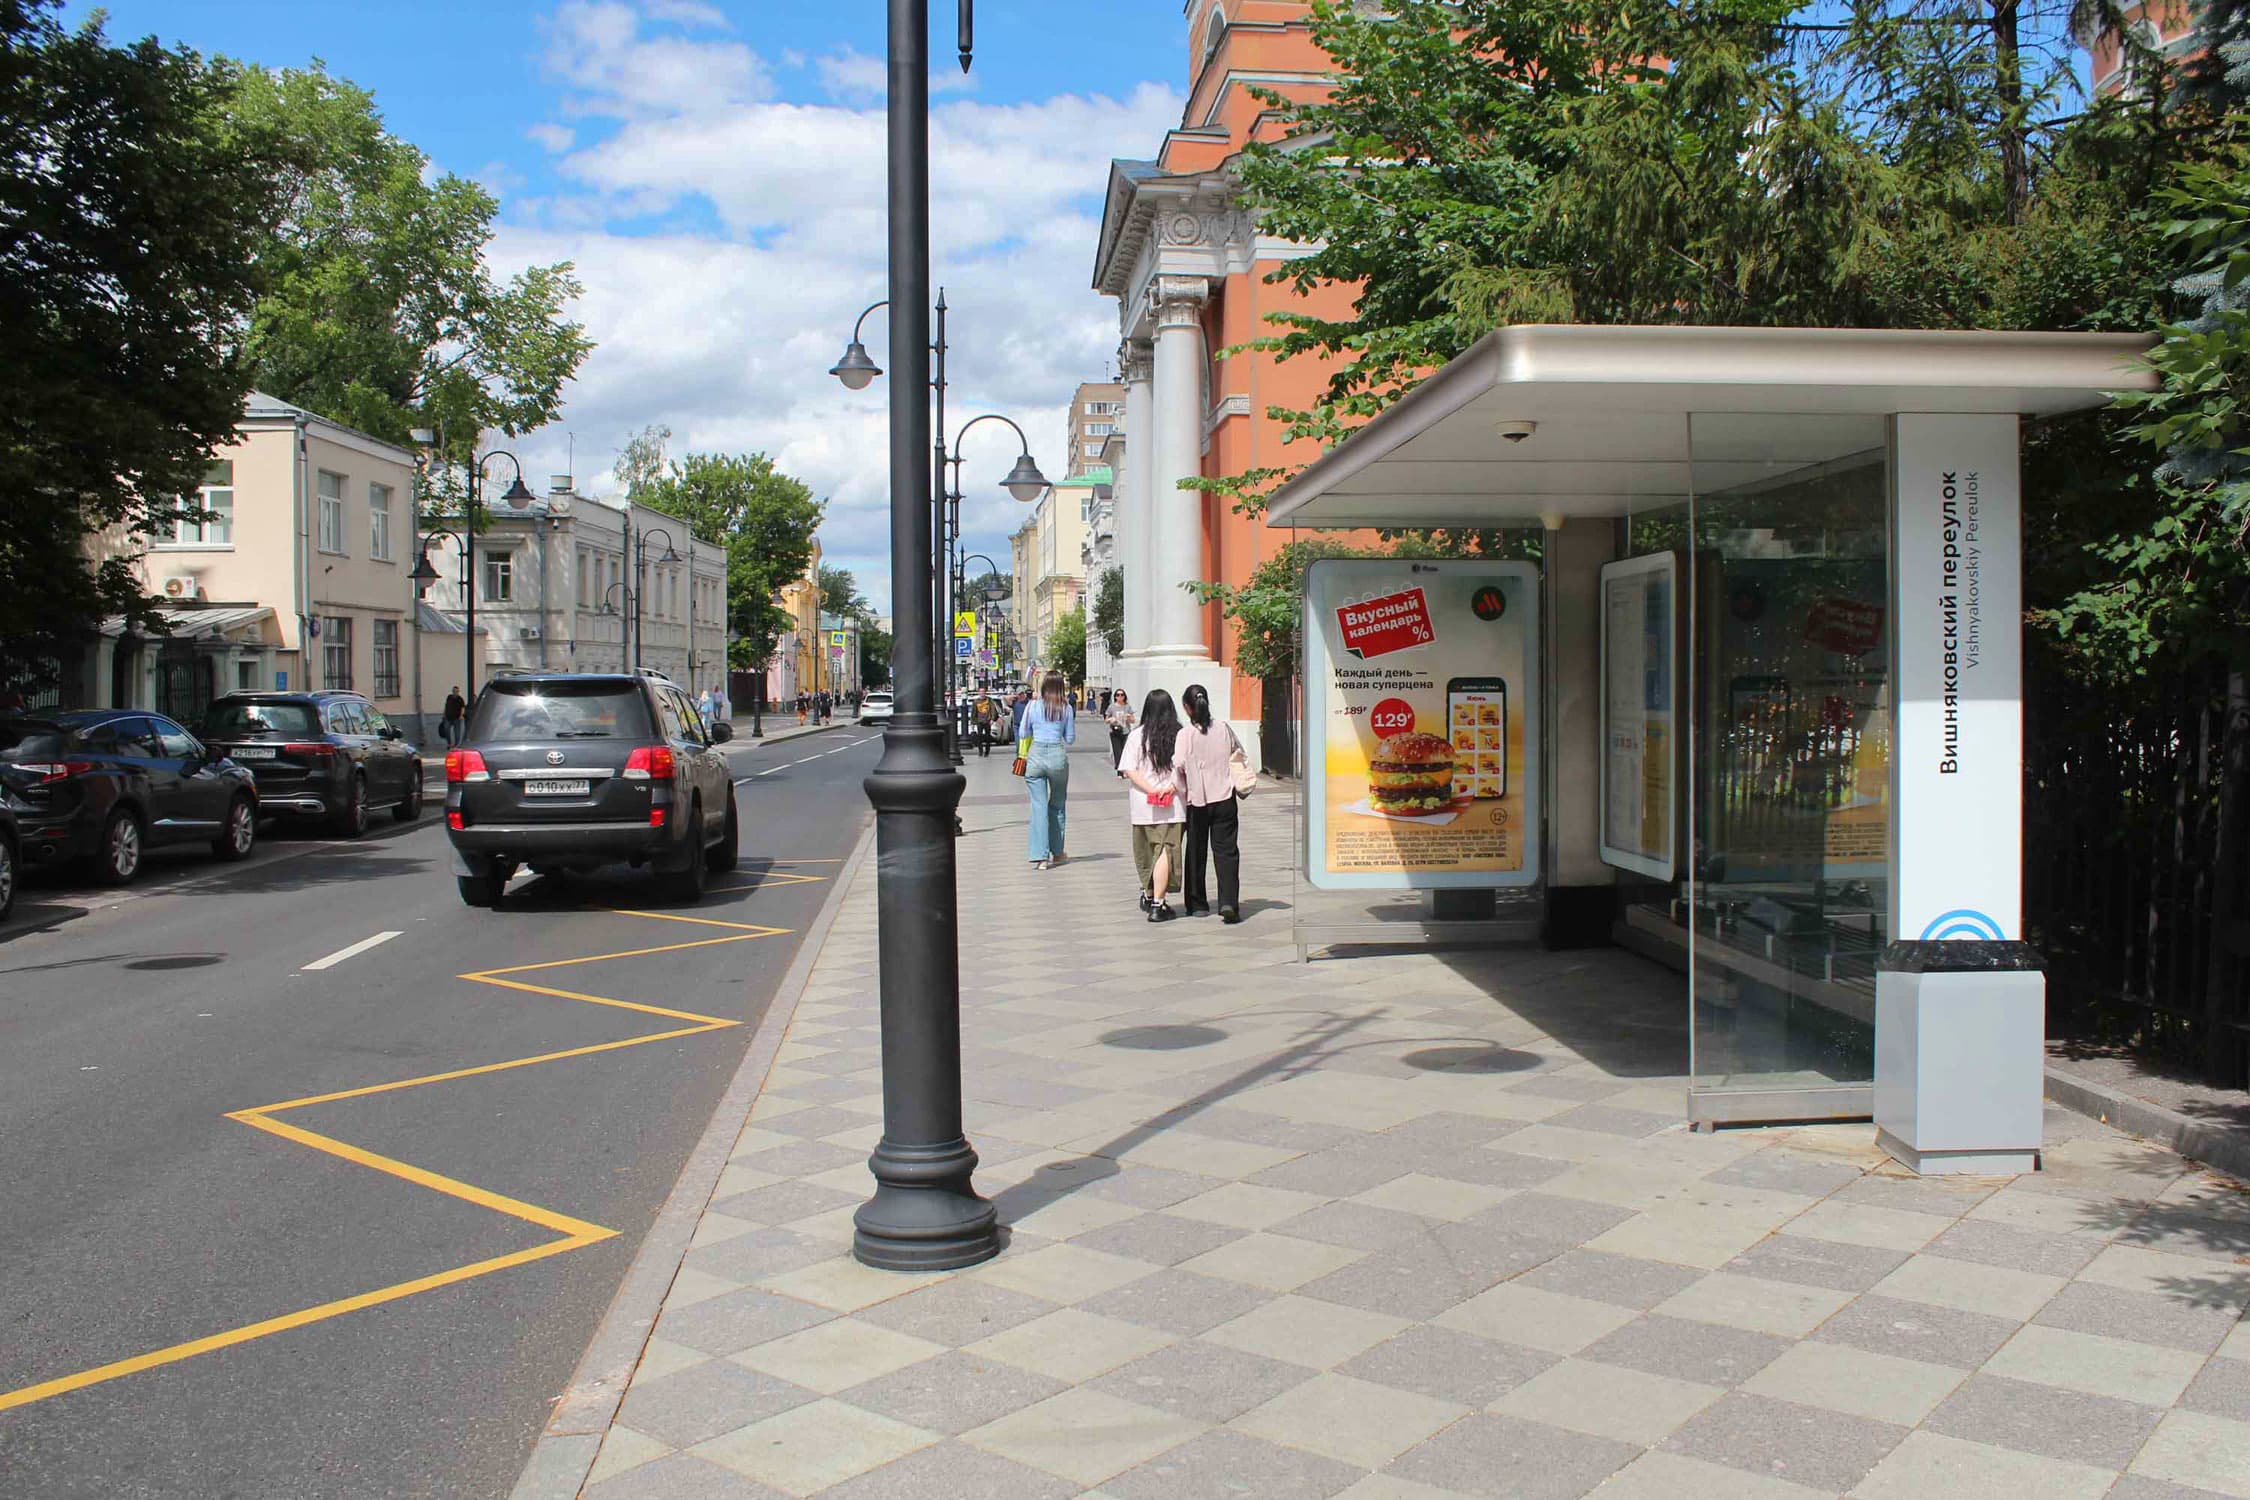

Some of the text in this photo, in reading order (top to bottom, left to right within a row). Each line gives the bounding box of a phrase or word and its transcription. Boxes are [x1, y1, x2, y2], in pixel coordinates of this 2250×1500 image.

[1964, 471, 1981, 669] Vishnyakovskiy Pereulok
[1344, 596, 1419, 626] Вкусный
[1939, 471, 1961, 774] Вишняковский переулок
[1349, 613, 1422, 639] календарь
[1412, 623, 1430, 642] %
[1335, 667, 1382, 679] Каждый
[1385, 670, 1413, 679] день
[1335, 681, 1433, 691] новая суперцена
